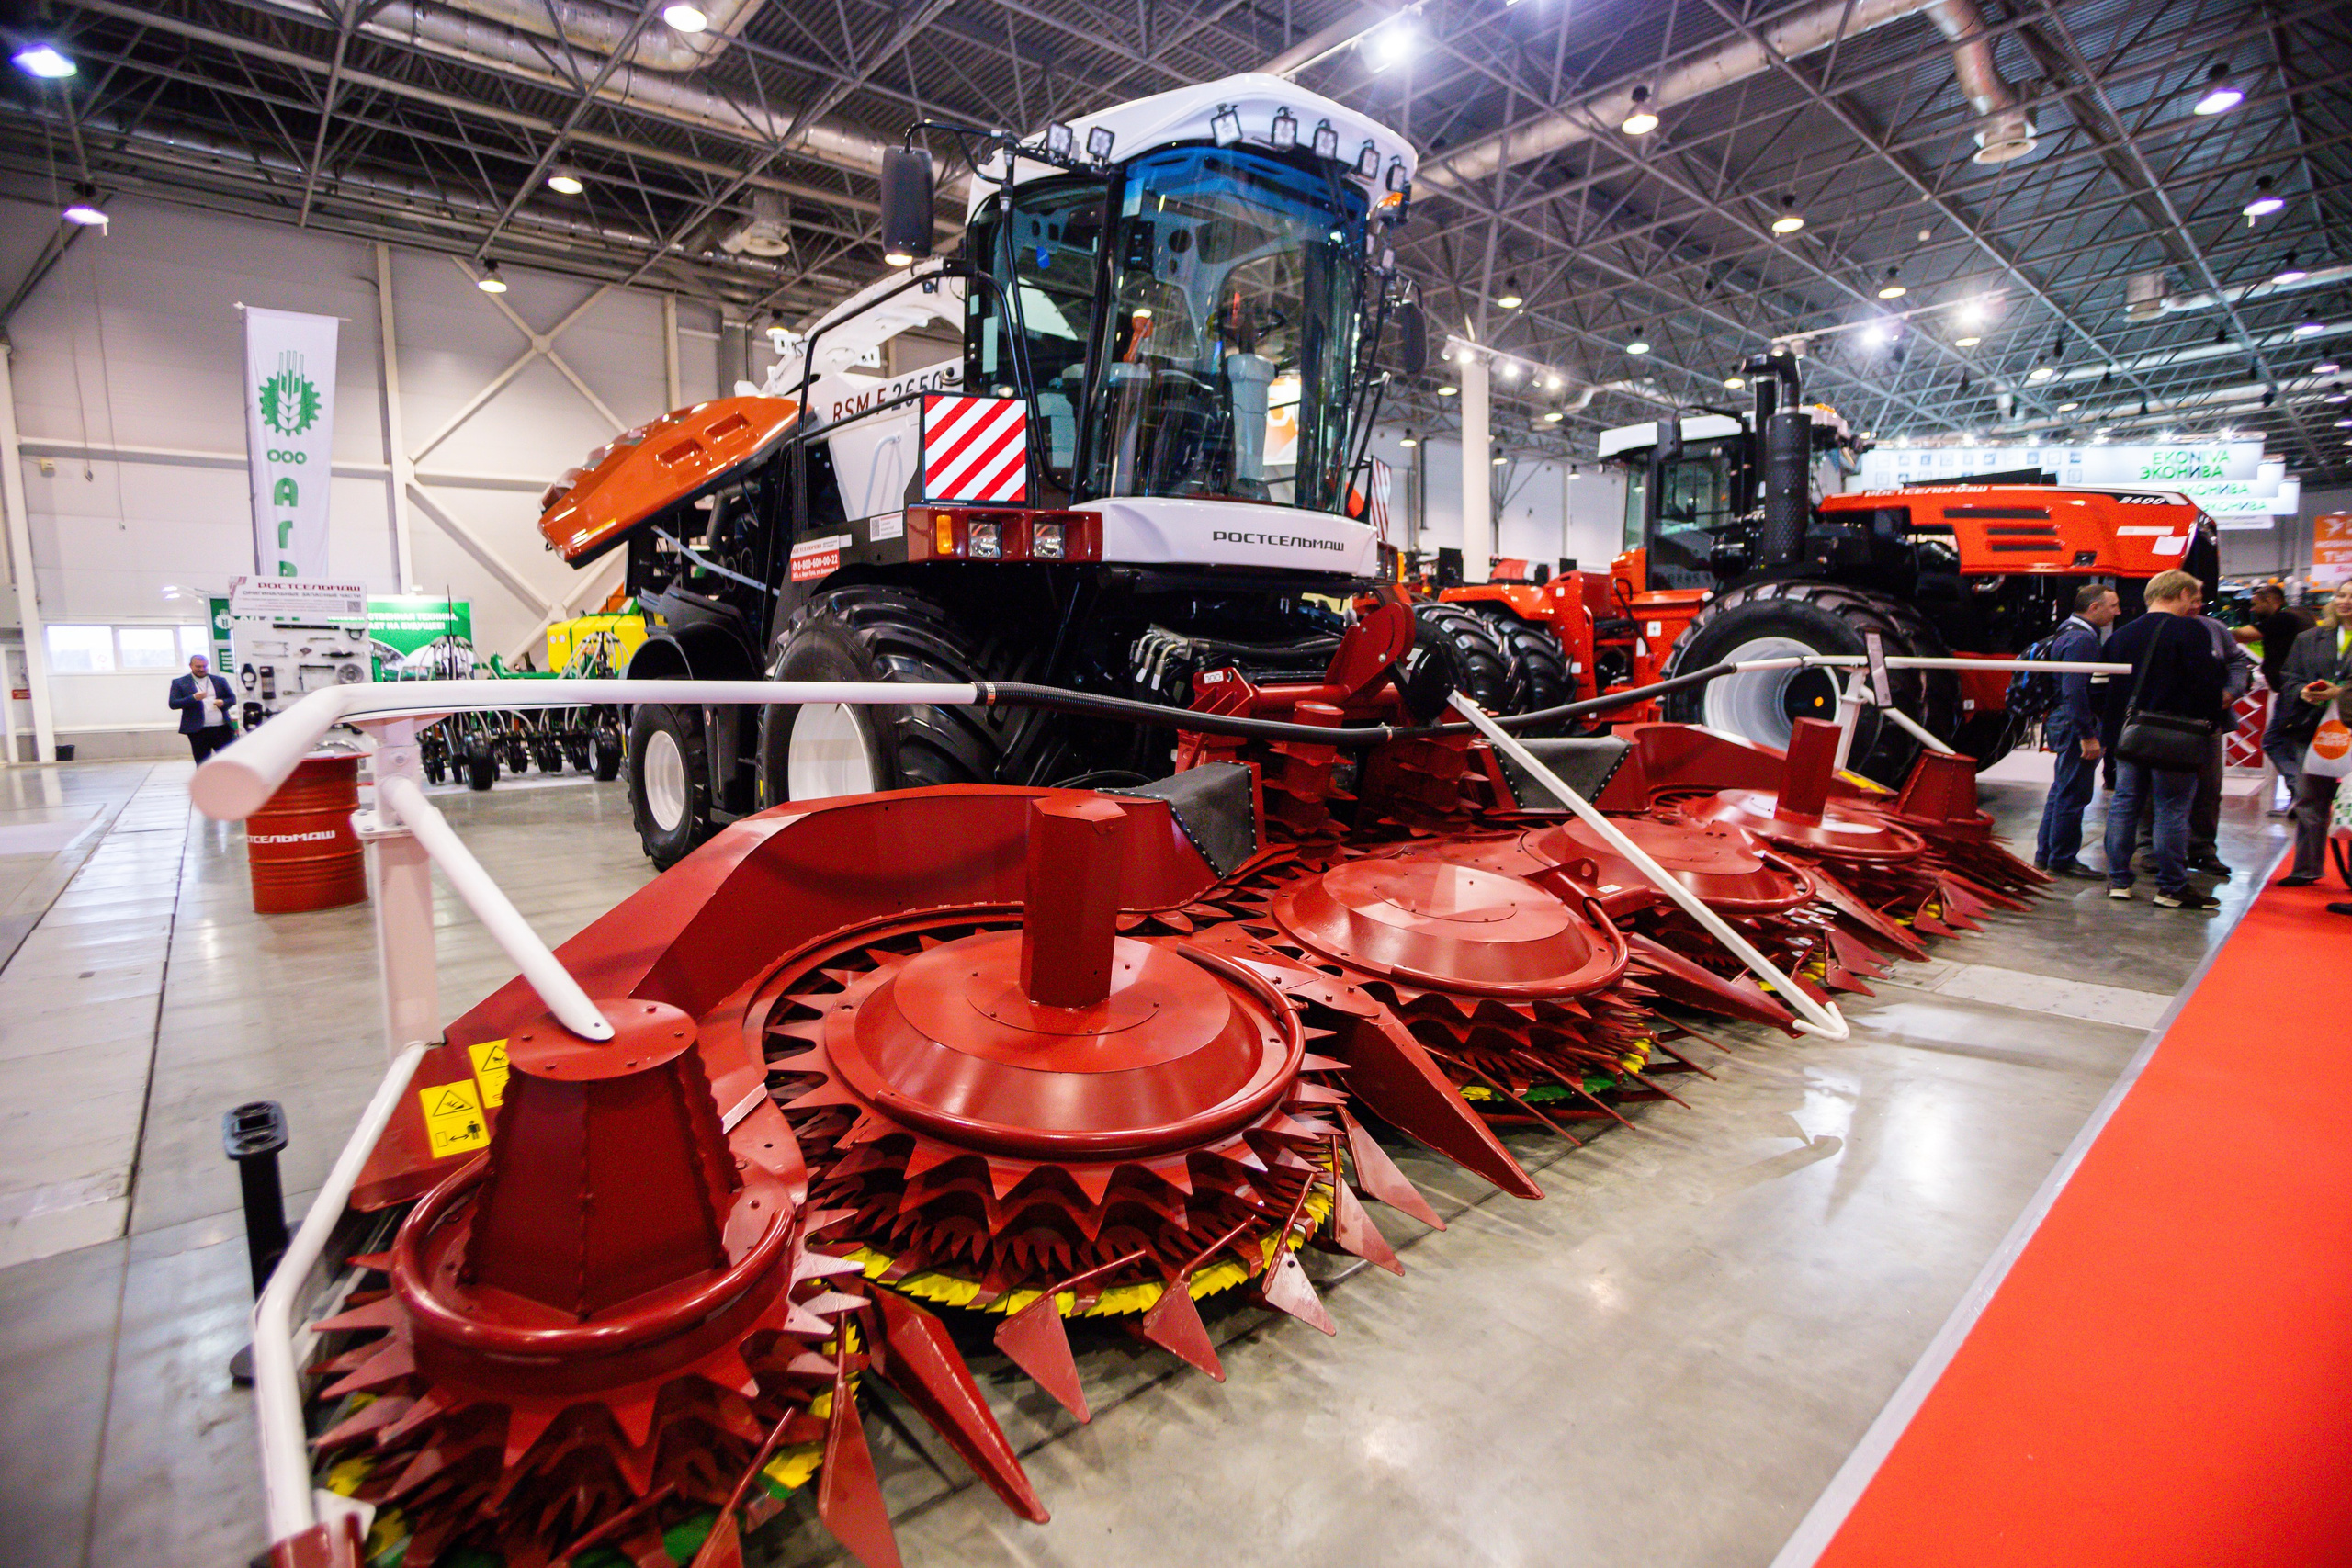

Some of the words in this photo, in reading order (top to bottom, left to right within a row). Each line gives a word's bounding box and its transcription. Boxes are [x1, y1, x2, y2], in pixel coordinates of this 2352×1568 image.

[832, 392, 870, 423] RSM
[876, 387, 887, 415] F
[266, 448, 308, 465] ООО
[2153, 450, 2232, 465] EKONIVA
[2139, 465, 2225, 479] ЭКОНИВА
[1213, 530, 1345, 552] РОСТСЕЛЬМАШ
[257, 582, 361, 592] РОСТСЕЛЬМАШ
